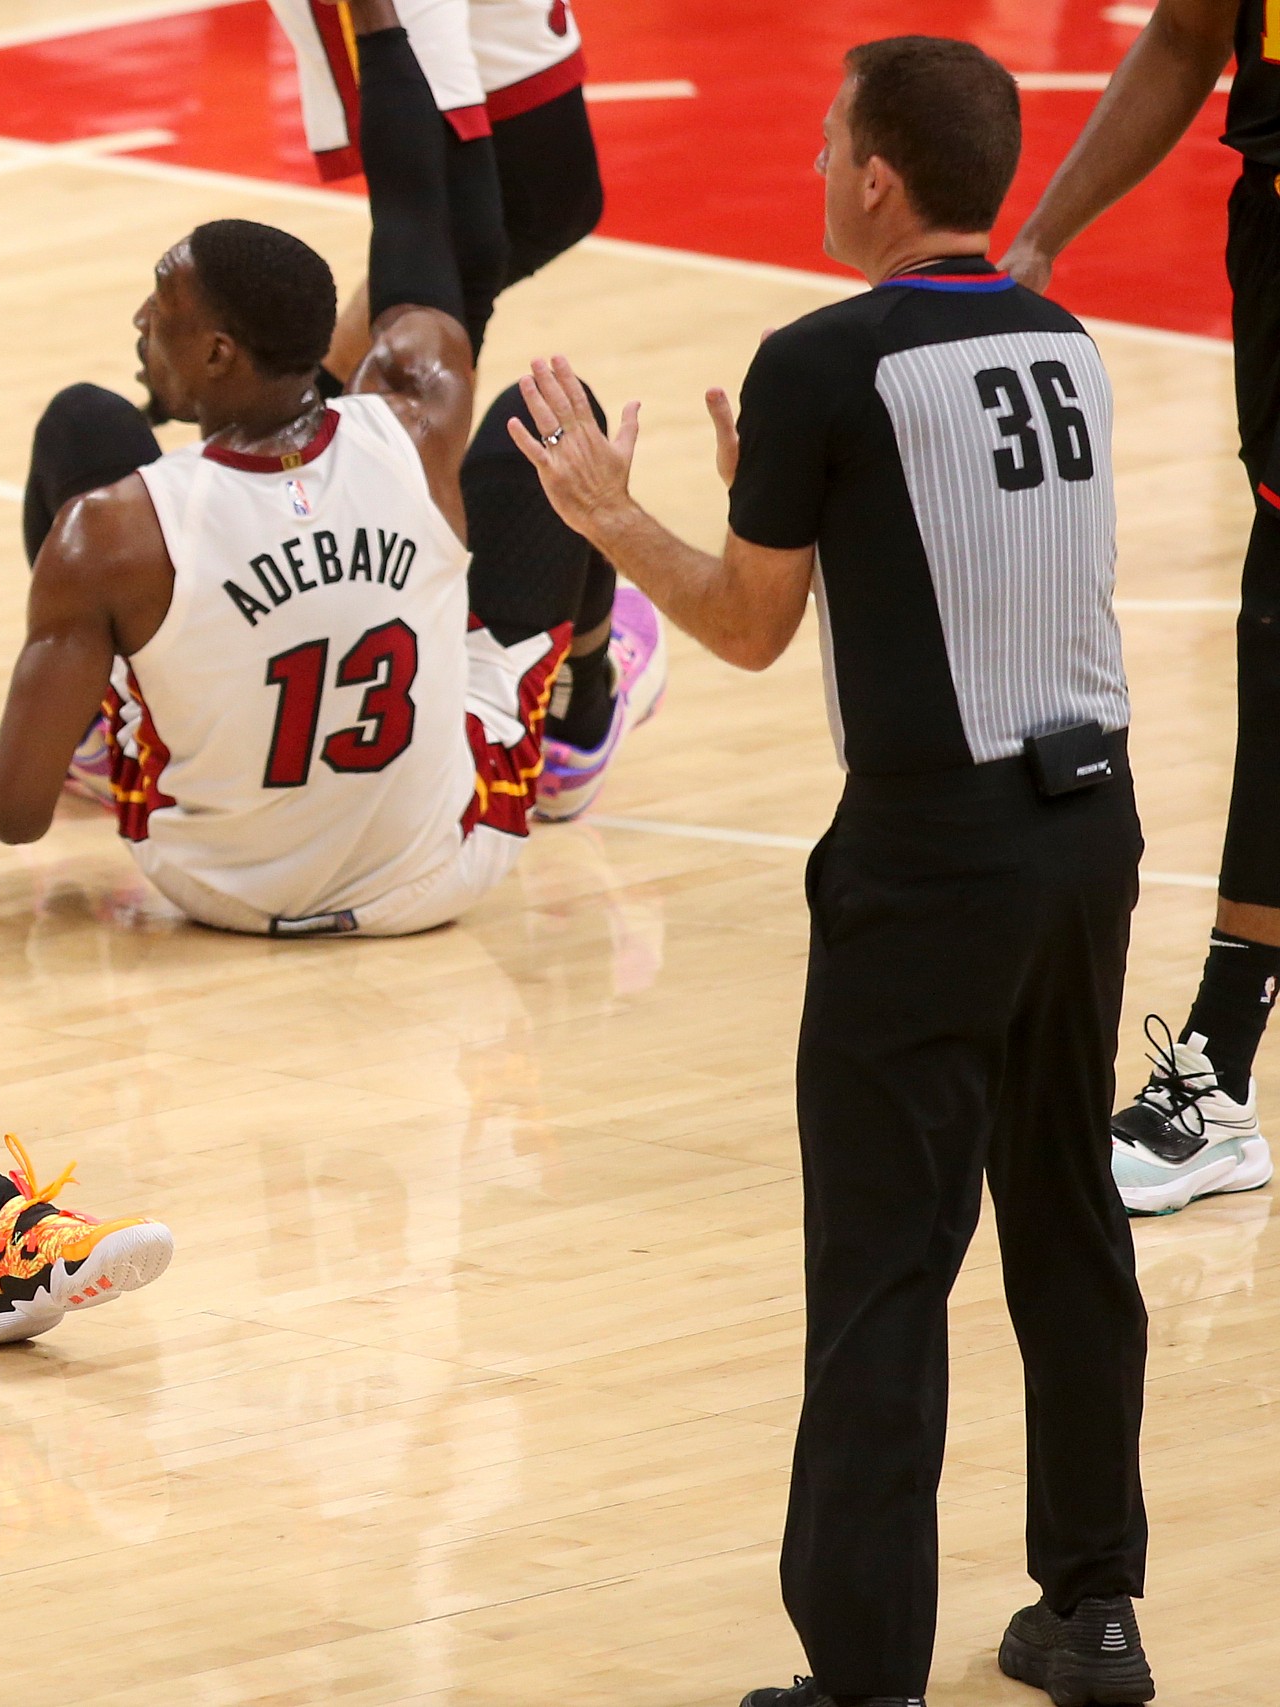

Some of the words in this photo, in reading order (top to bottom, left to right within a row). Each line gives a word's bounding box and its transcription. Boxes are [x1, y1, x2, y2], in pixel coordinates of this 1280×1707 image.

[974, 359, 1094, 492] 36
[222, 527, 417, 627] ADEBAYO
[262, 617, 418, 789] 13
